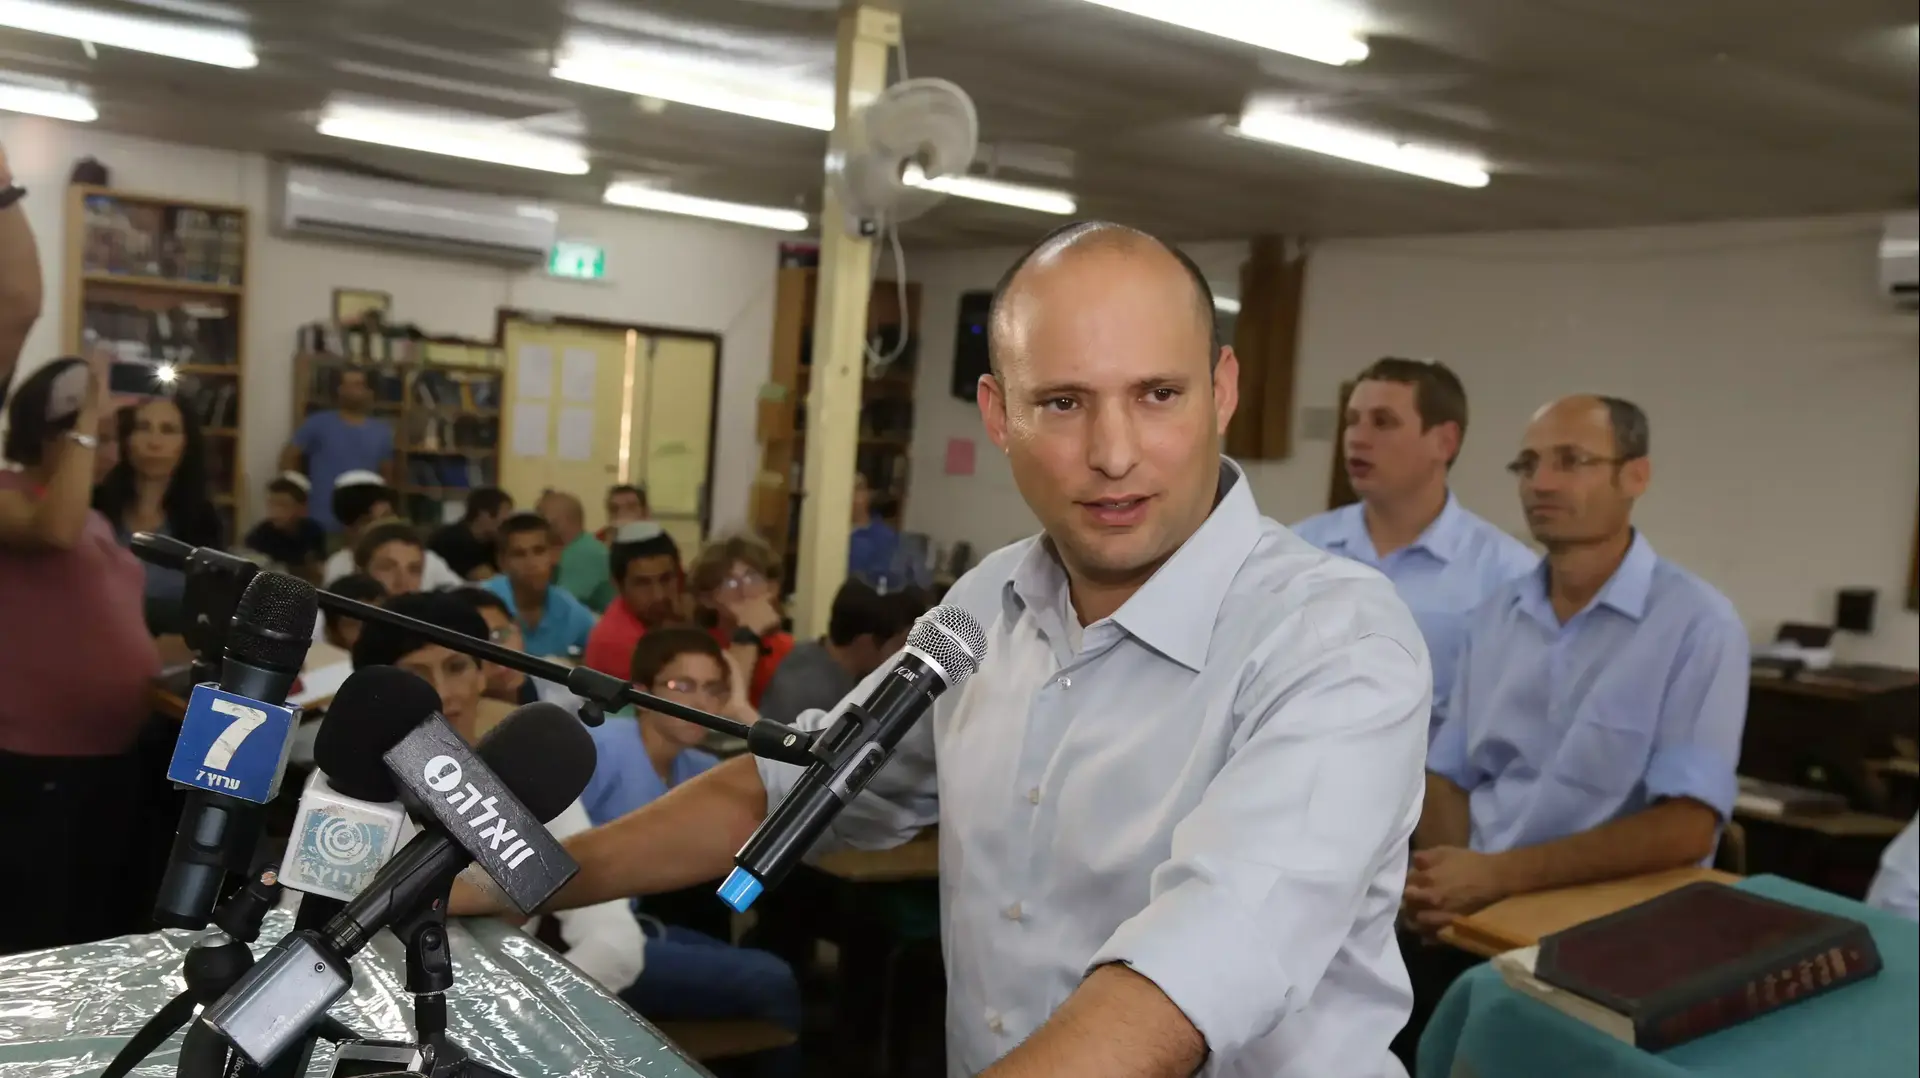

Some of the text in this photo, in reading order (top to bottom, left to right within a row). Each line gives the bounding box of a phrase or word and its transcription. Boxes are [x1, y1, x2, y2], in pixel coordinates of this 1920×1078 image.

[203, 698, 267, 771] 7
[195, 769, 241, 790] ערוץ 7
